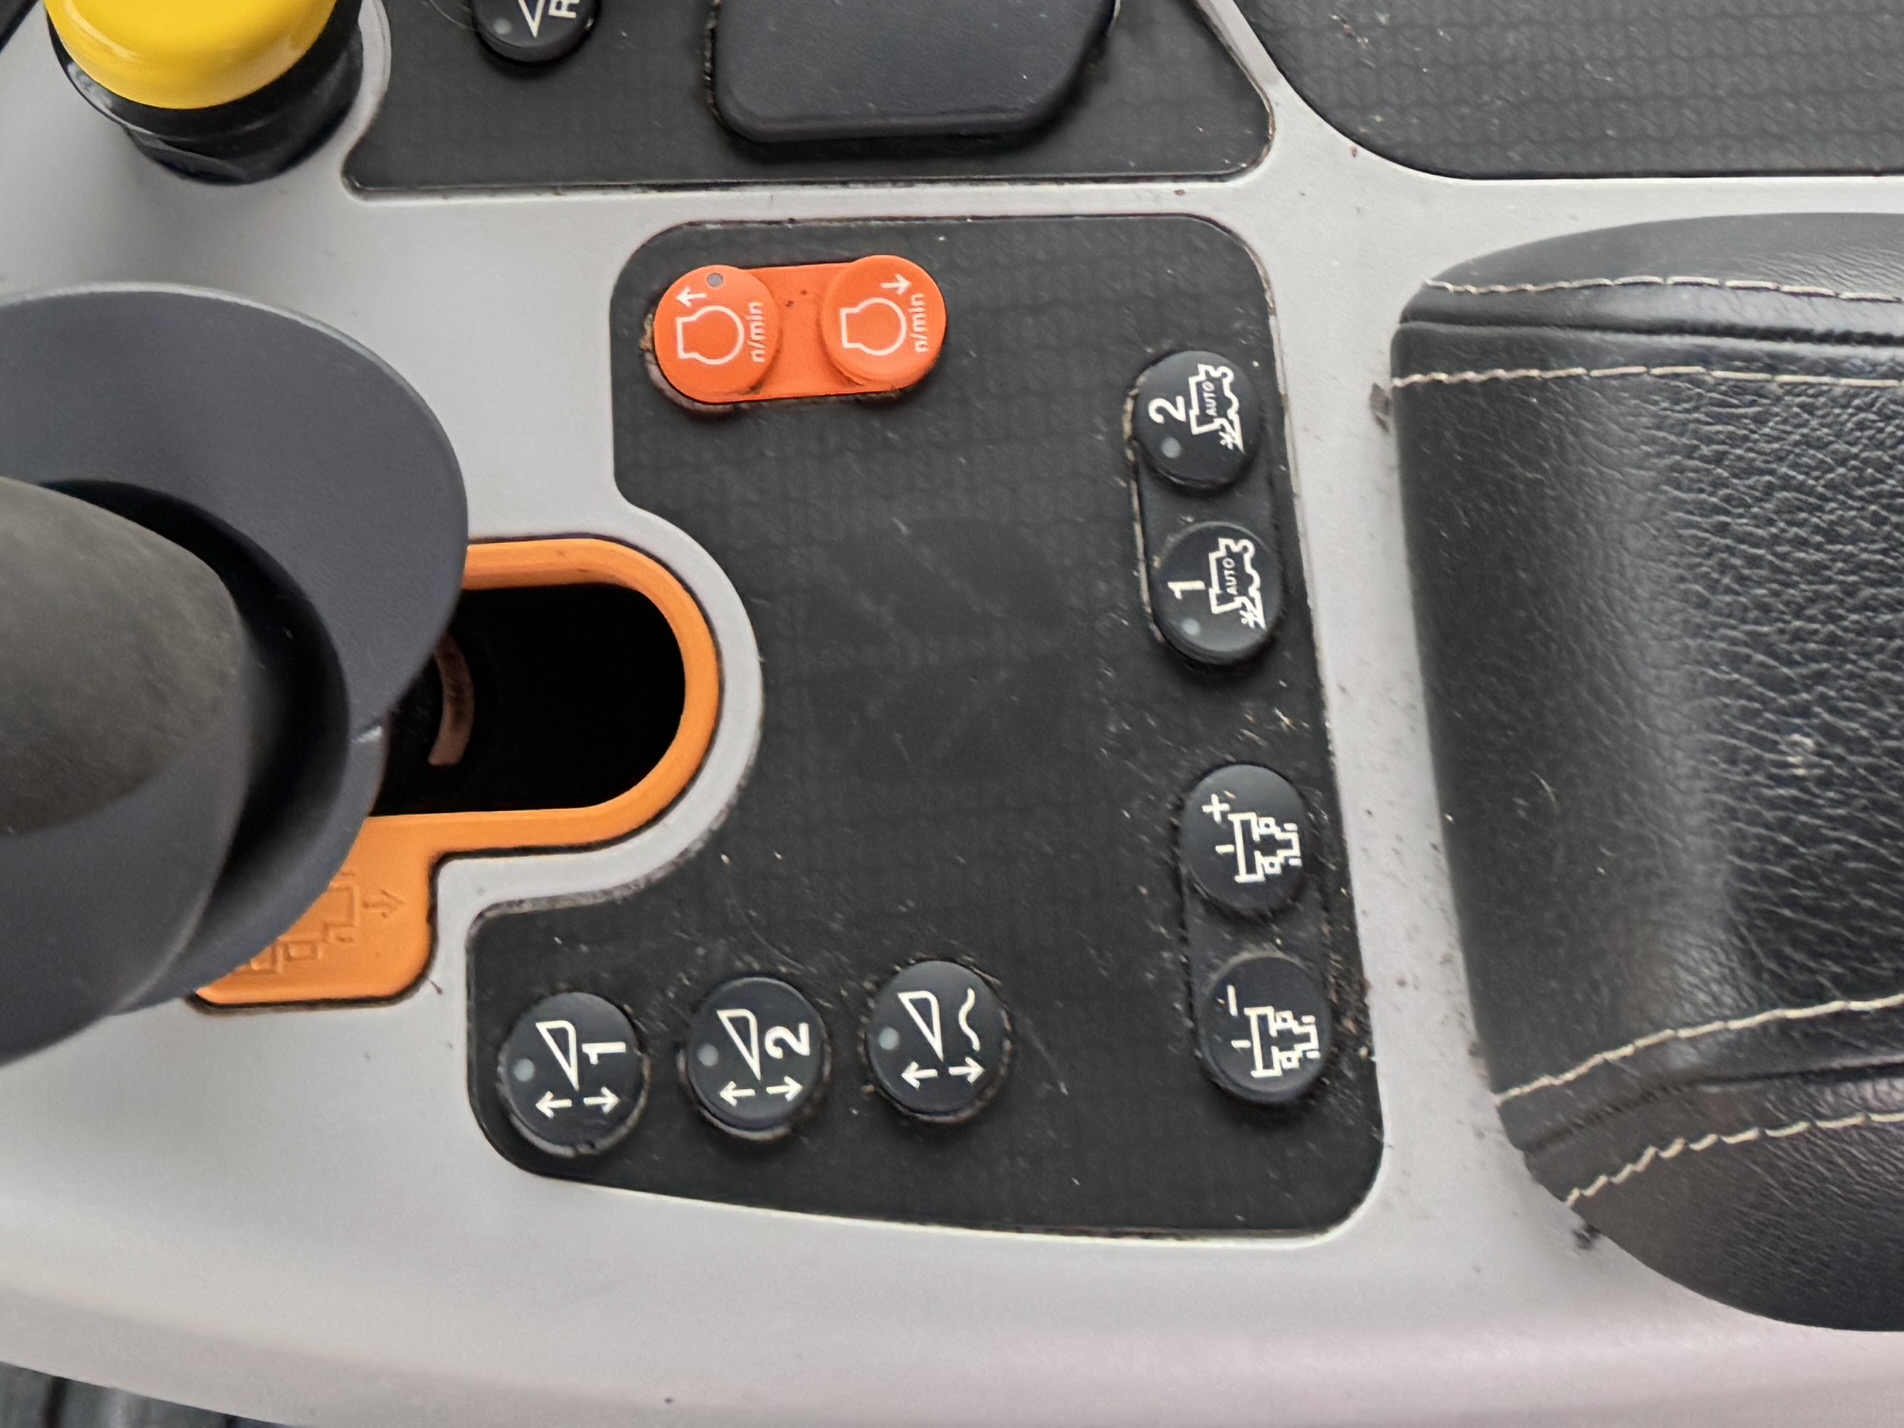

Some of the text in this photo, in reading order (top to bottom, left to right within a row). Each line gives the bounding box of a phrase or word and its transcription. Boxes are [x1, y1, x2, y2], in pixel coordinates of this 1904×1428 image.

[746, 300, 767, 363] n/min
[910, 292, 929, 354] n/min
[1147, 395, 1187, 424] 2
[1201, 380, 1218, 417] AUTO
[1167, 579, 1206, 600] 1
[1222, 557, 1238, 596] AUTO
[581, 1041, 627, 1066] 1
[764, 1022, 811, 1060] 2
